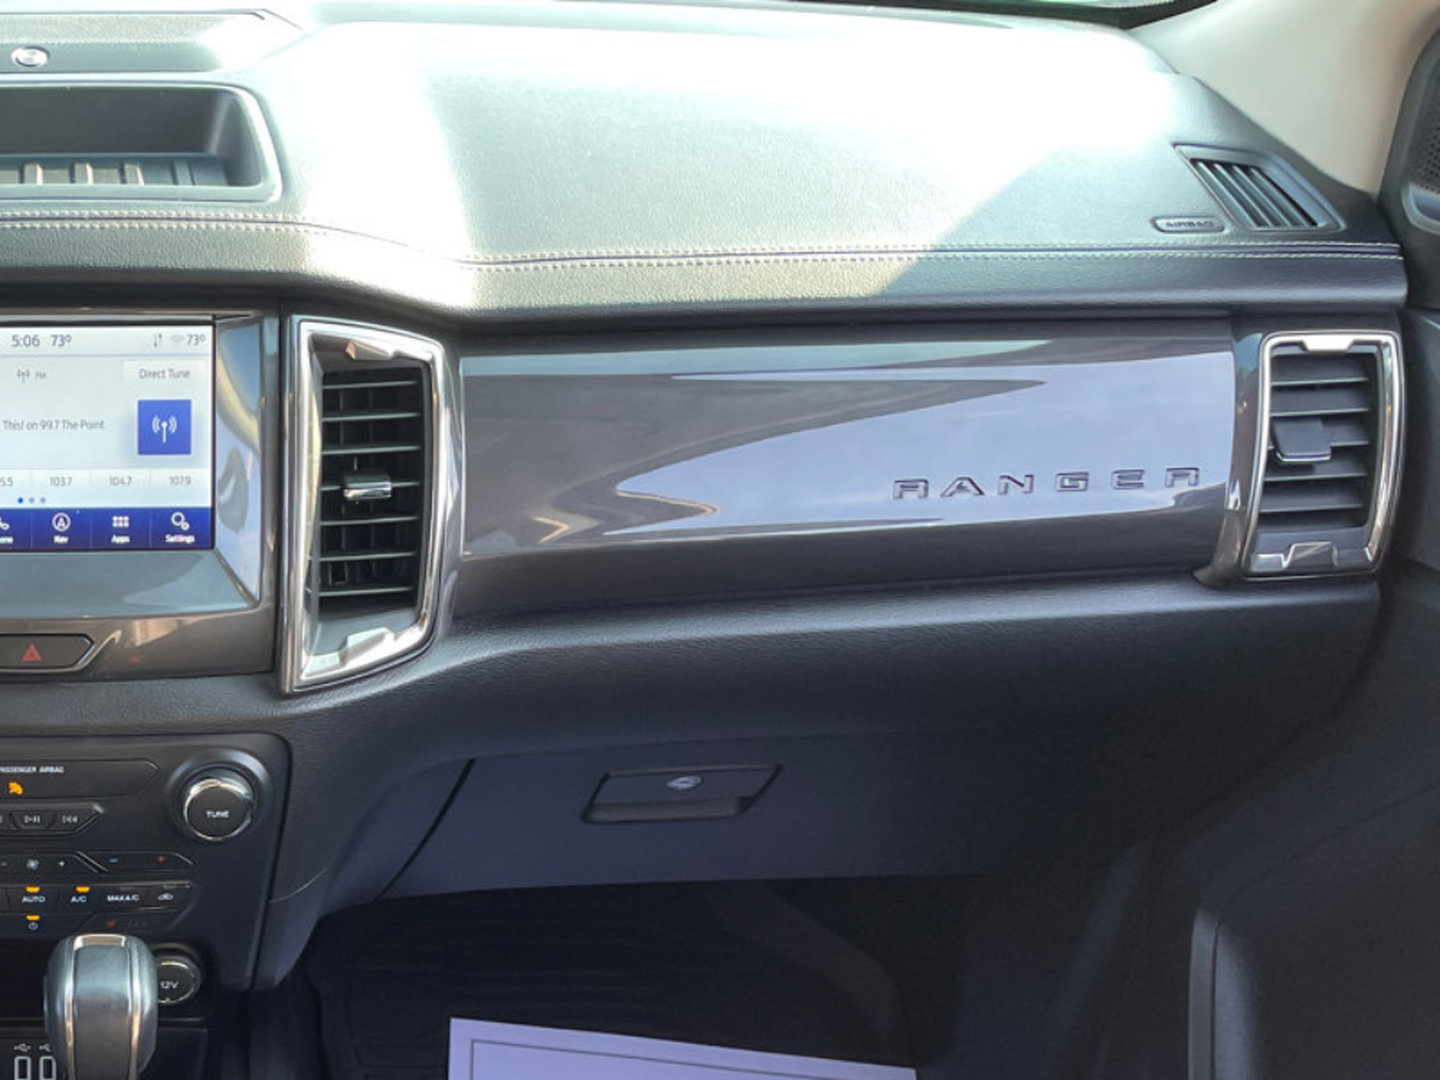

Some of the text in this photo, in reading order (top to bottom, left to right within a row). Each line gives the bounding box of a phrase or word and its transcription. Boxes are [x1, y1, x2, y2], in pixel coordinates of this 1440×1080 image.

[11, 334, 41, 348] 5:06
[138, 368, 191, 379] Direct Tune
[26, 422, 39, 431] on
[61, 419, 78, 431] The
[79, 419, 105, 431] Point
[892, 466, 1201, 500] RANGER
[53, 535, 69, 544] Nav
[110, 535, 131, 544] Apps
[164, 534, 196, 544] Settings
[38, 765, 65, 774] AIRBAG
[206, 809, 231, 819] TUNE
[21, 895, 46, 904] AUTO
[71, 895, 87, 903] A/C
[107, 894, 126, 902] MAX
[160, 979, 180, 990] 12V
